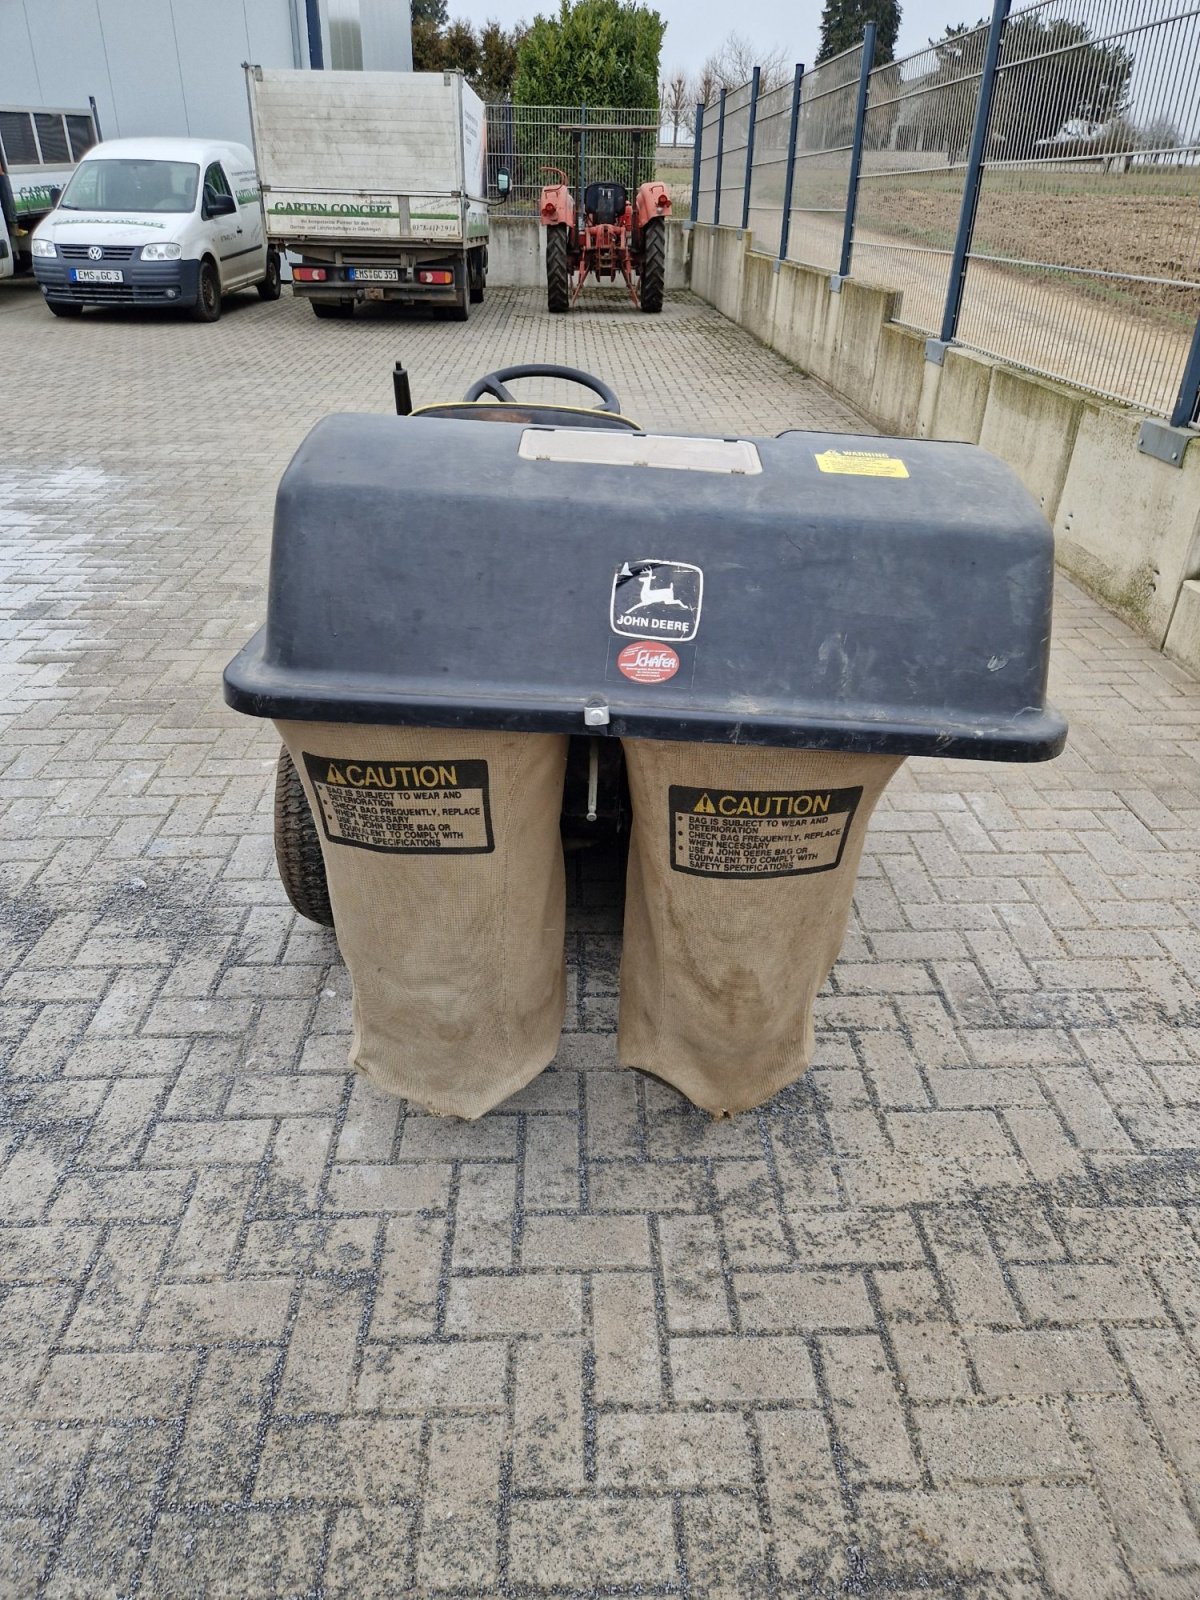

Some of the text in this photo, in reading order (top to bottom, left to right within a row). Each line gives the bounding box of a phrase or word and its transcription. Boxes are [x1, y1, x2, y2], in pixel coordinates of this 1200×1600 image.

[275, 202, 392, 214] GARTEN CONCEPT
[78, 270, 120, 281] EMS GC 3
[355, 270, 398, 280] EMS GC 351
[616, 615, 690, 632] JOHN DEERE
[346, 765, 457, 788] CAUTION
[326, 786, 342, 795] BAG
[345, 789, 353, 797] IS
[356, 791, 395, 800] SUBJECT
[443, 791, 462, 799] AND
[329, 794, 393, 807] DETERIORATION
[719, 794, 831, 817] CAUTION
[332, 801, 358, 812] CHECK
[361, 806, 378, 814] BAG
[442, 808, 480, 816] REPLACE
[333, 808, 409, 823] WHEN NECESSARY
[689, 816, 707, 825] BAG
[722, 819, 763, 827] SUBJECT
[810, 816, 828, 824] AND
[337, 816, 351, 824] USE
[362, 821, 383, 829] JOHN
[340, 823, 386, 837] EQUIVALENT
[689, 824, 758, 834] DETERIORATION
[689, 831, 717, 840] CHECK
[804, 828, 841, 840] REPLACE
[342, 830, 441, 847] SAFETY SPECIFICATIONS
[689, 839, 769, 850] WHEN NECESSARY
[689, 846, 705, 854] USE
[689, 853, 741, 864] EQUIVALENT
[760, 855, 794, 863] COMPLY
[798, 853, 818, 861] WITH
[689, 861, 794, 871] SAFETY SPECIFICATIONS
